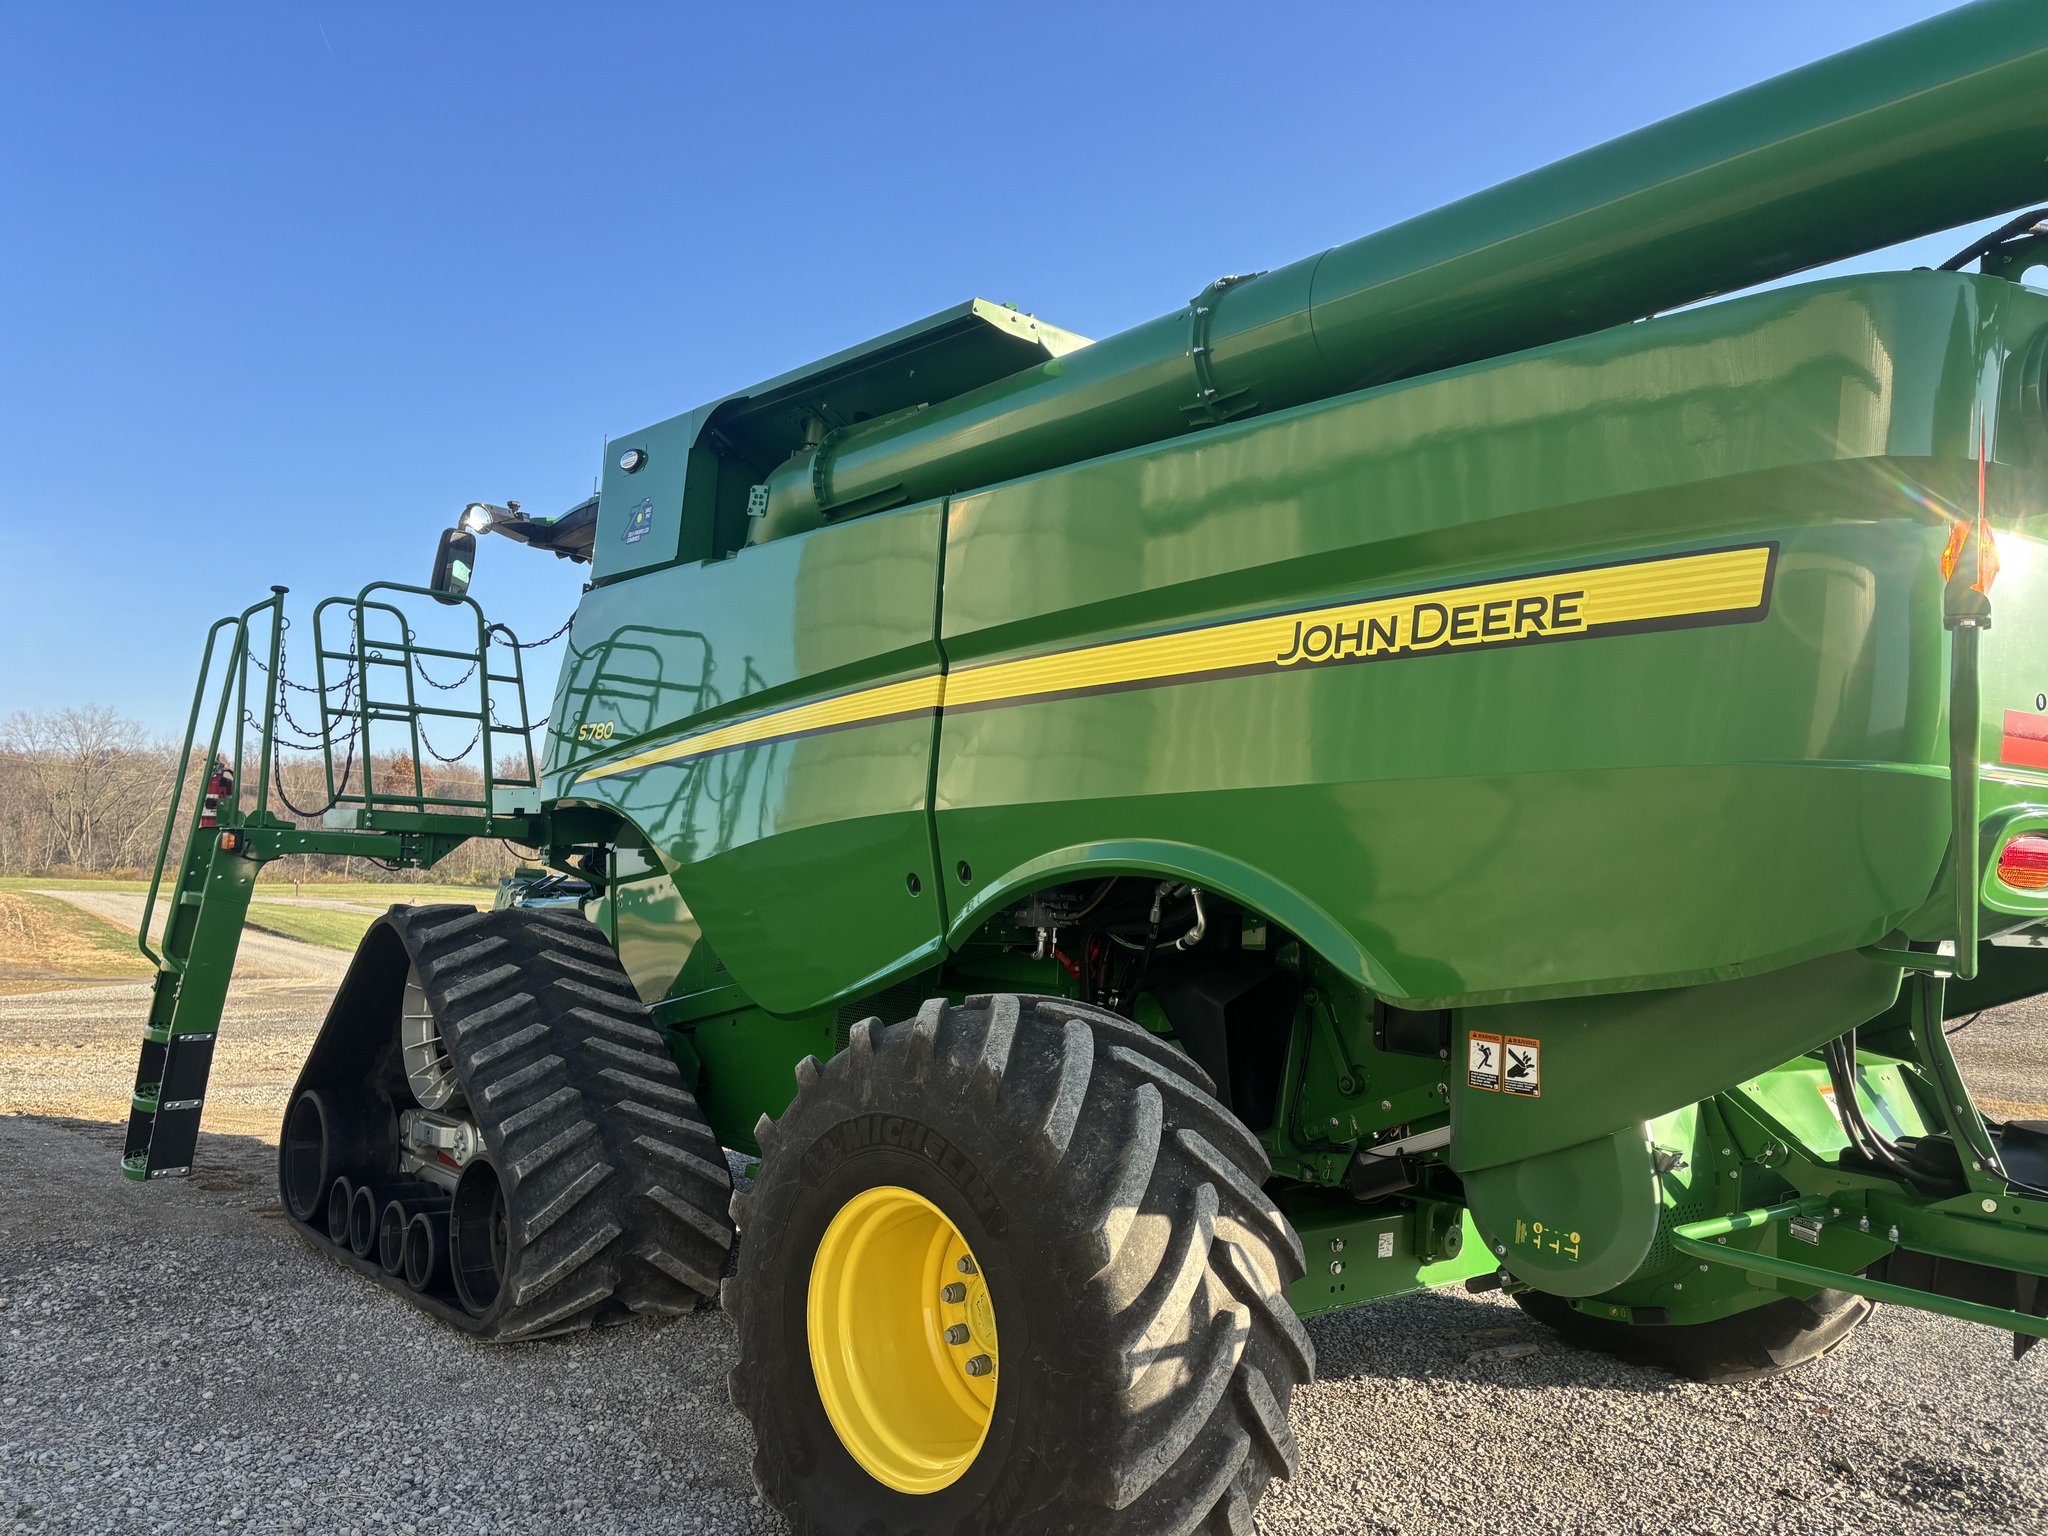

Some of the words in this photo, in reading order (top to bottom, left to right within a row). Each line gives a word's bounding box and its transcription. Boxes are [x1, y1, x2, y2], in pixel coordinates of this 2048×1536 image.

[1277, 614, 1399, 662] JOHN
[1410, 590, 1585, 646] DEERE
[578, 721, 614, 741] S780
[1478, 1033, 1499, 1041] WARNING
[1513, 1038, 1537, 1046] WARNING
[842, 1115, 1000, 1213] MICHELIN
